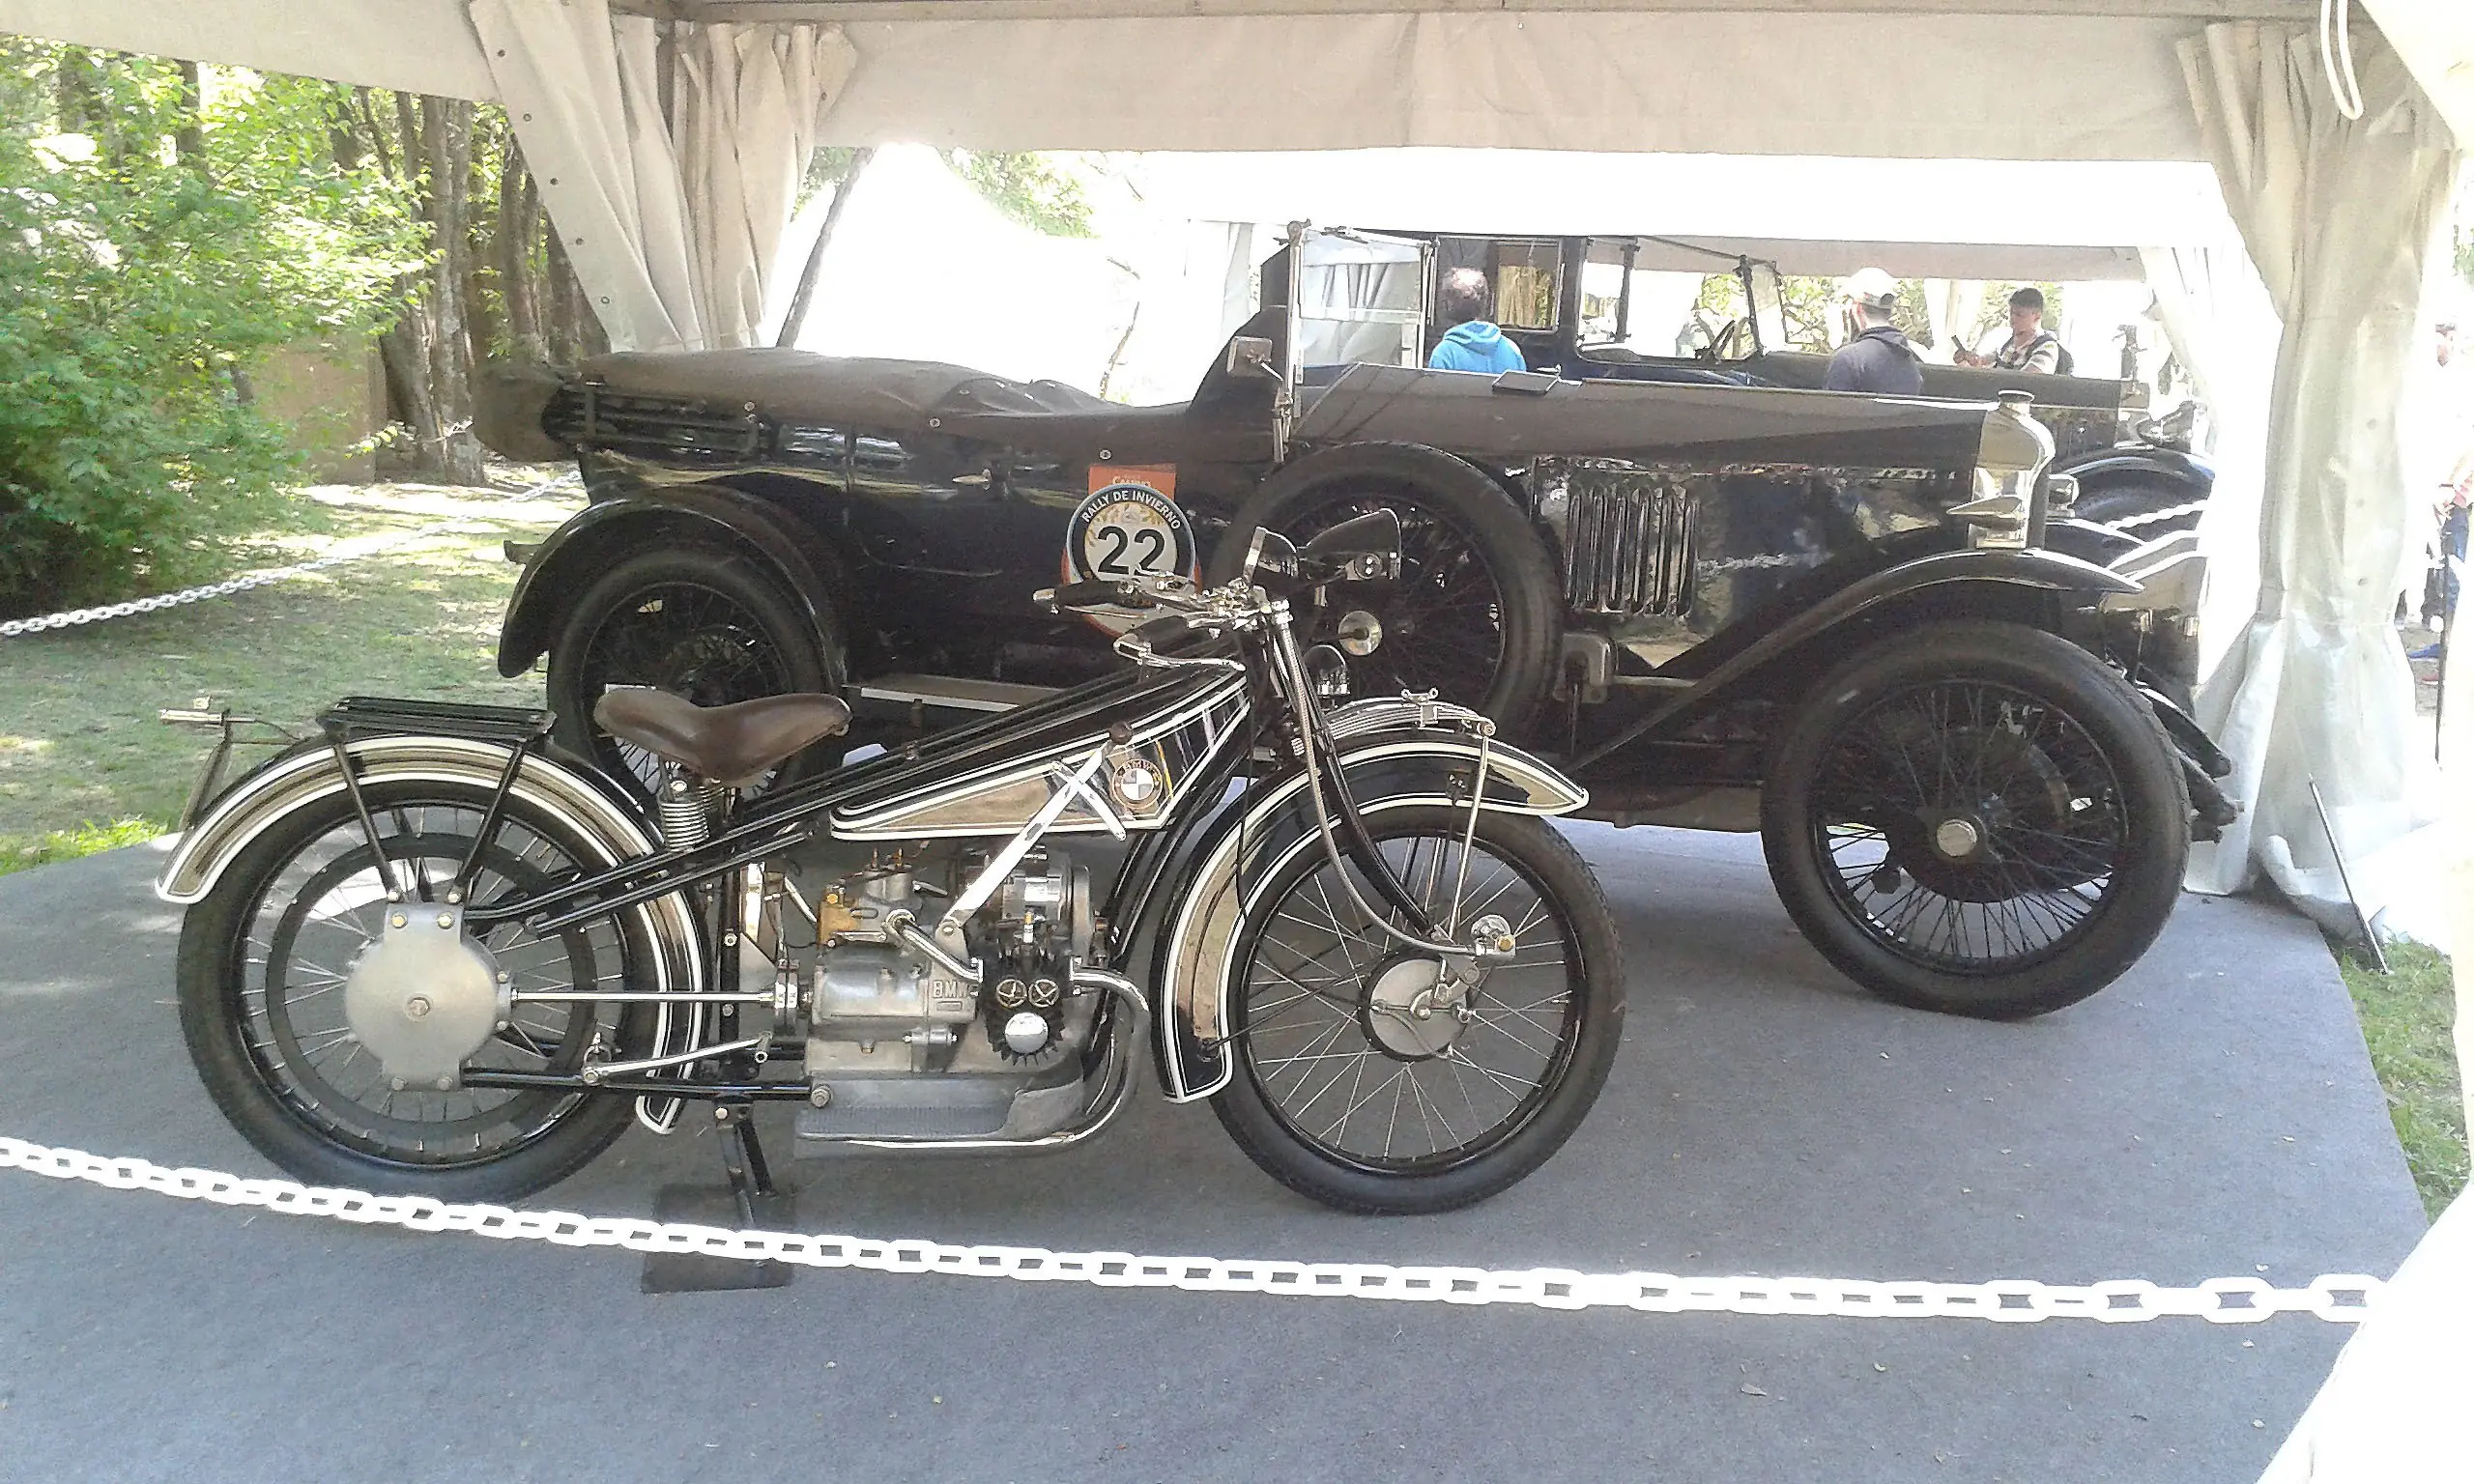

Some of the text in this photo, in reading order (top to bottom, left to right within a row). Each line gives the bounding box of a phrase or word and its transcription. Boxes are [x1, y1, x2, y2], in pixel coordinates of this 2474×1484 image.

[1081, 490, 1181, 529] RALLY DE INVIERNO
[1097, 526, 1165, 577] 22
[933, 980, 968, 998] BMW
